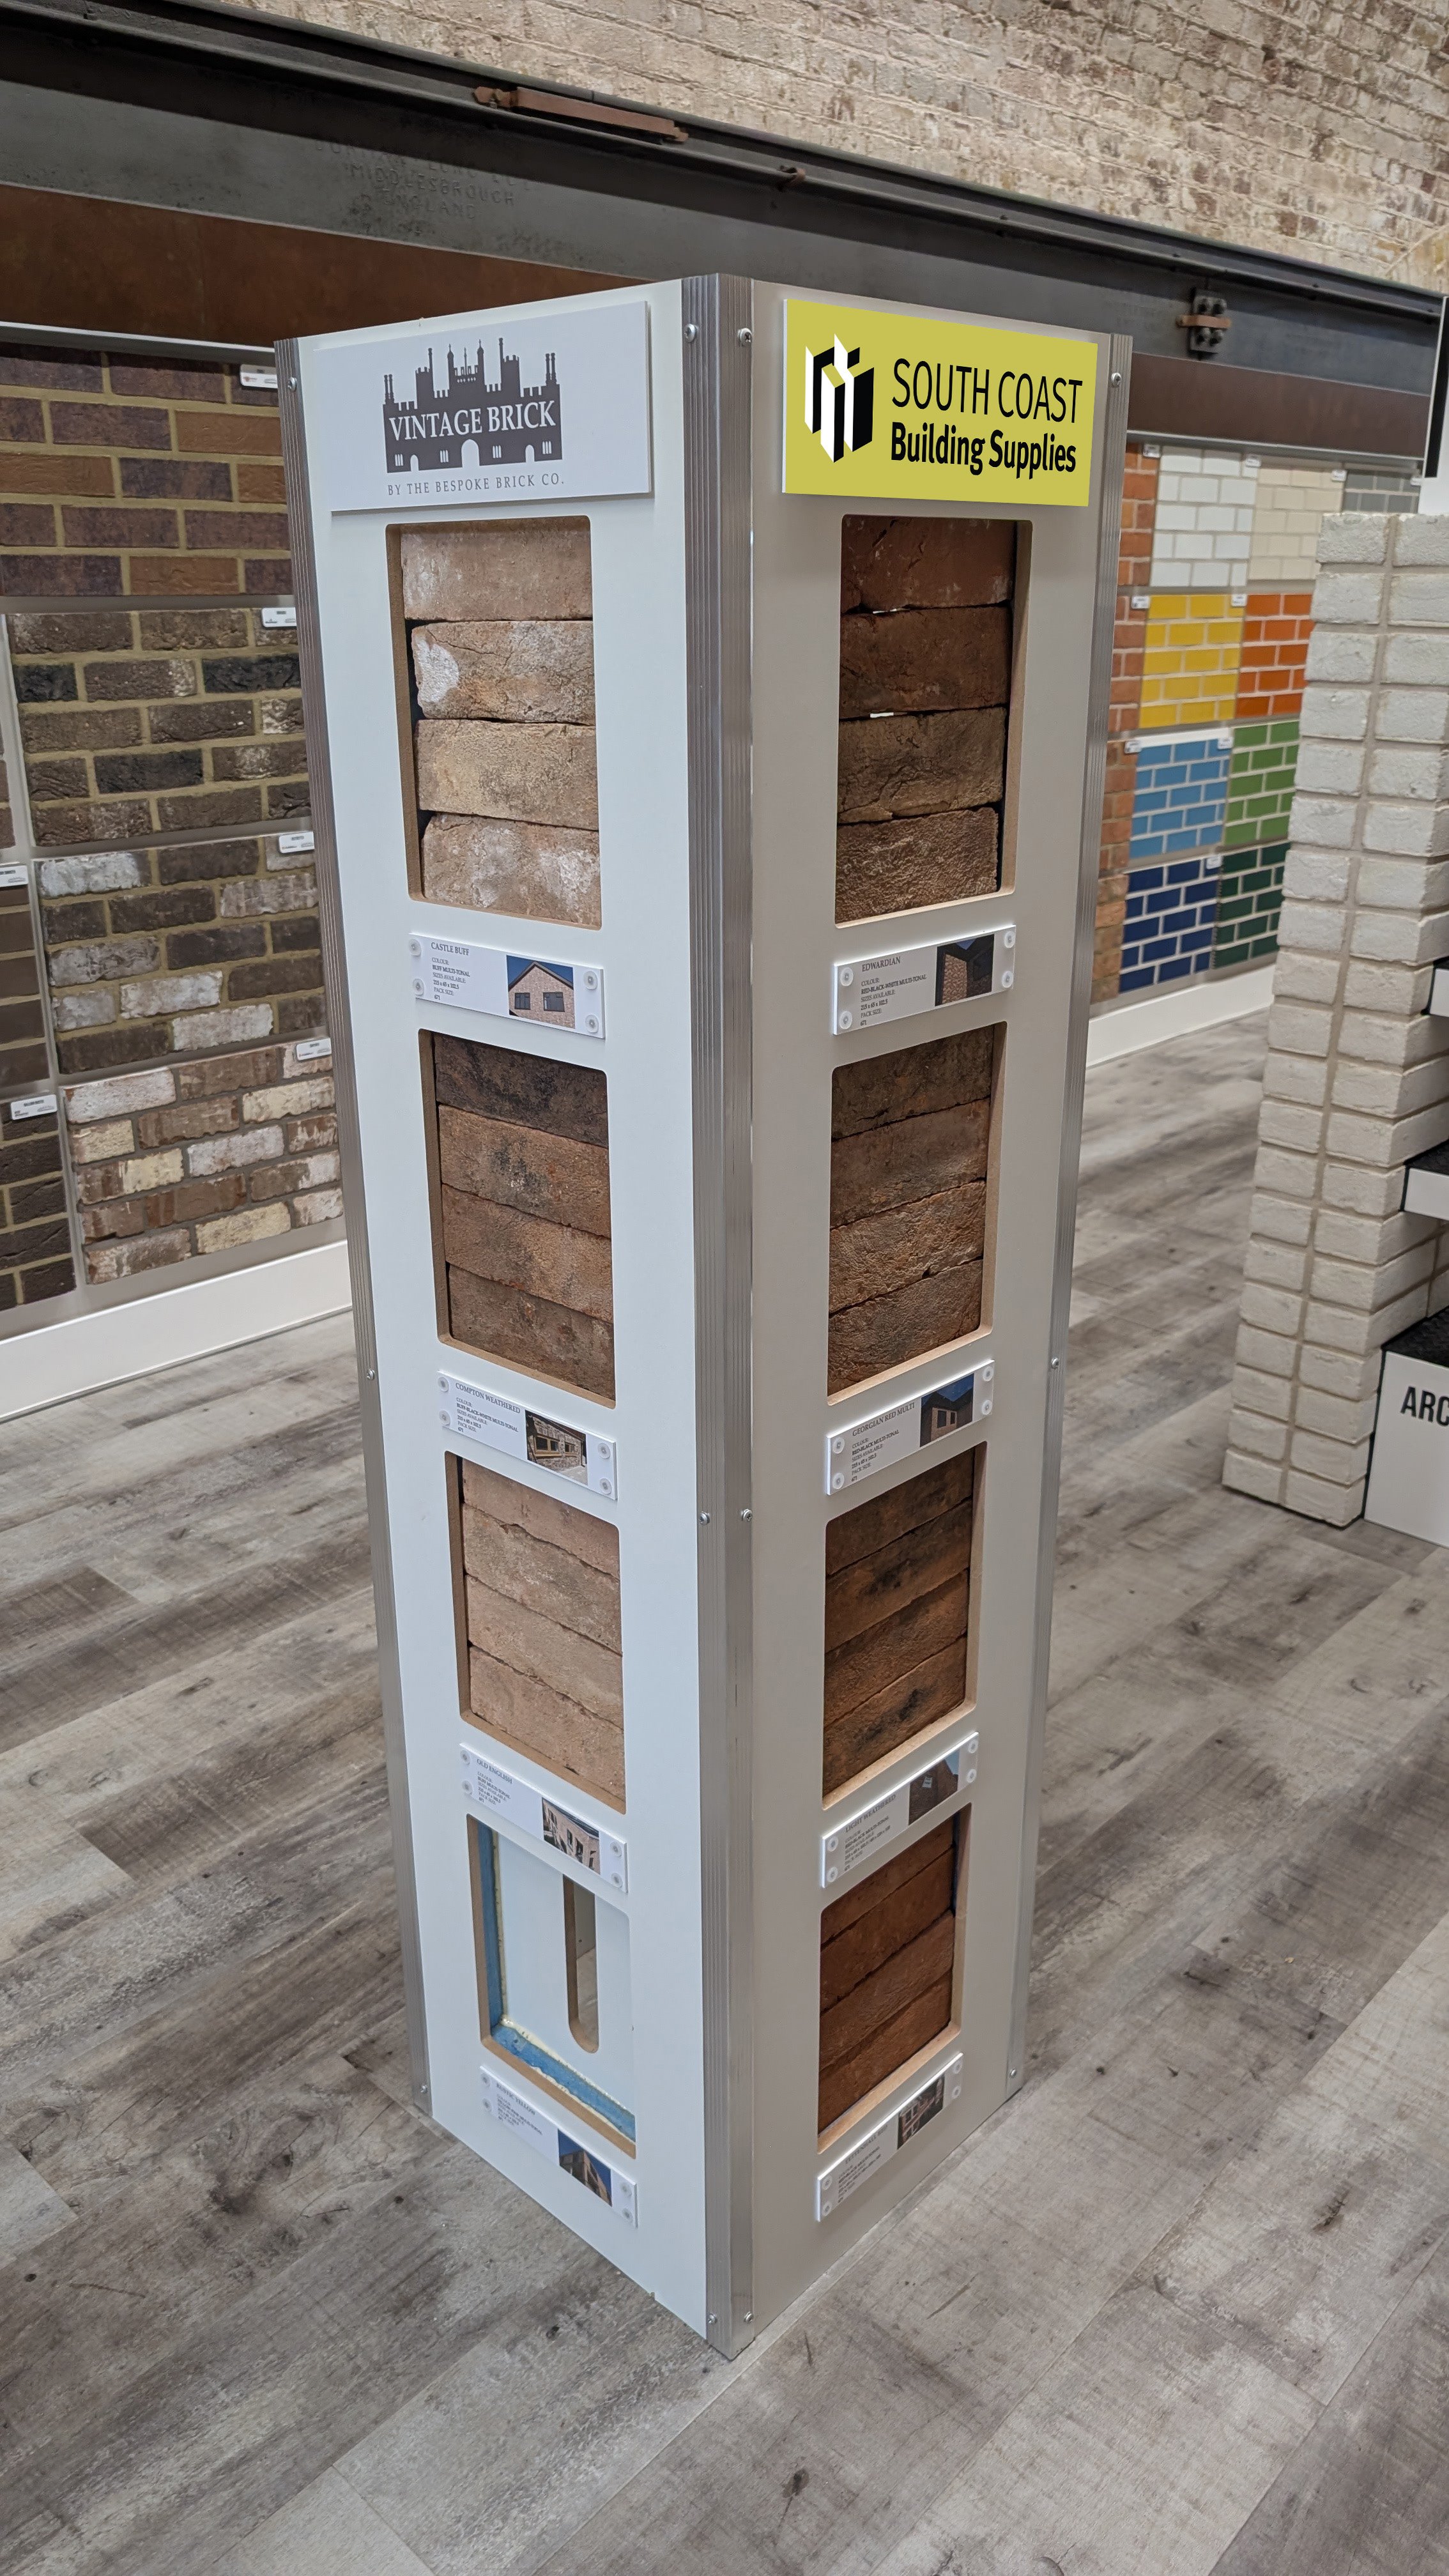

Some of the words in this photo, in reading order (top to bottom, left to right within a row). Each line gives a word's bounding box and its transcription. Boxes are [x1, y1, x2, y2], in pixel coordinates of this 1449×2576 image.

[892, 358, 989, 415] SOUTH
[998, 371, 1084, 424] COAST
[389, 408, 482, 441] VINTAGE
[487, 400, 556, 432] BRICK
[891, 421, 986, 476] Building
[988, 429, 1077, 480] Supplies
[387, 483, 401, 496] BY
[407, 481, 429, 494] THE
[435, 477, 489, 493] BESPOKE
[496, 475, 535, 489] BRICK
[542, 471, 565, 486] CO.
[431, 942, 454, 953] CASTLE
[455, 946, 470, 956] BUFF
[862, 956, 901, 972] EDWARDIAN
[456, 1383, 484, 1399] COMPTON
[485, 1394, 521, 1414] WEATHERED
[852, 1417, 884, 1437] GEORGIAN
[885, 1412, 896, 1422] RED
[897, 1402, 915, 1416] MULTI
